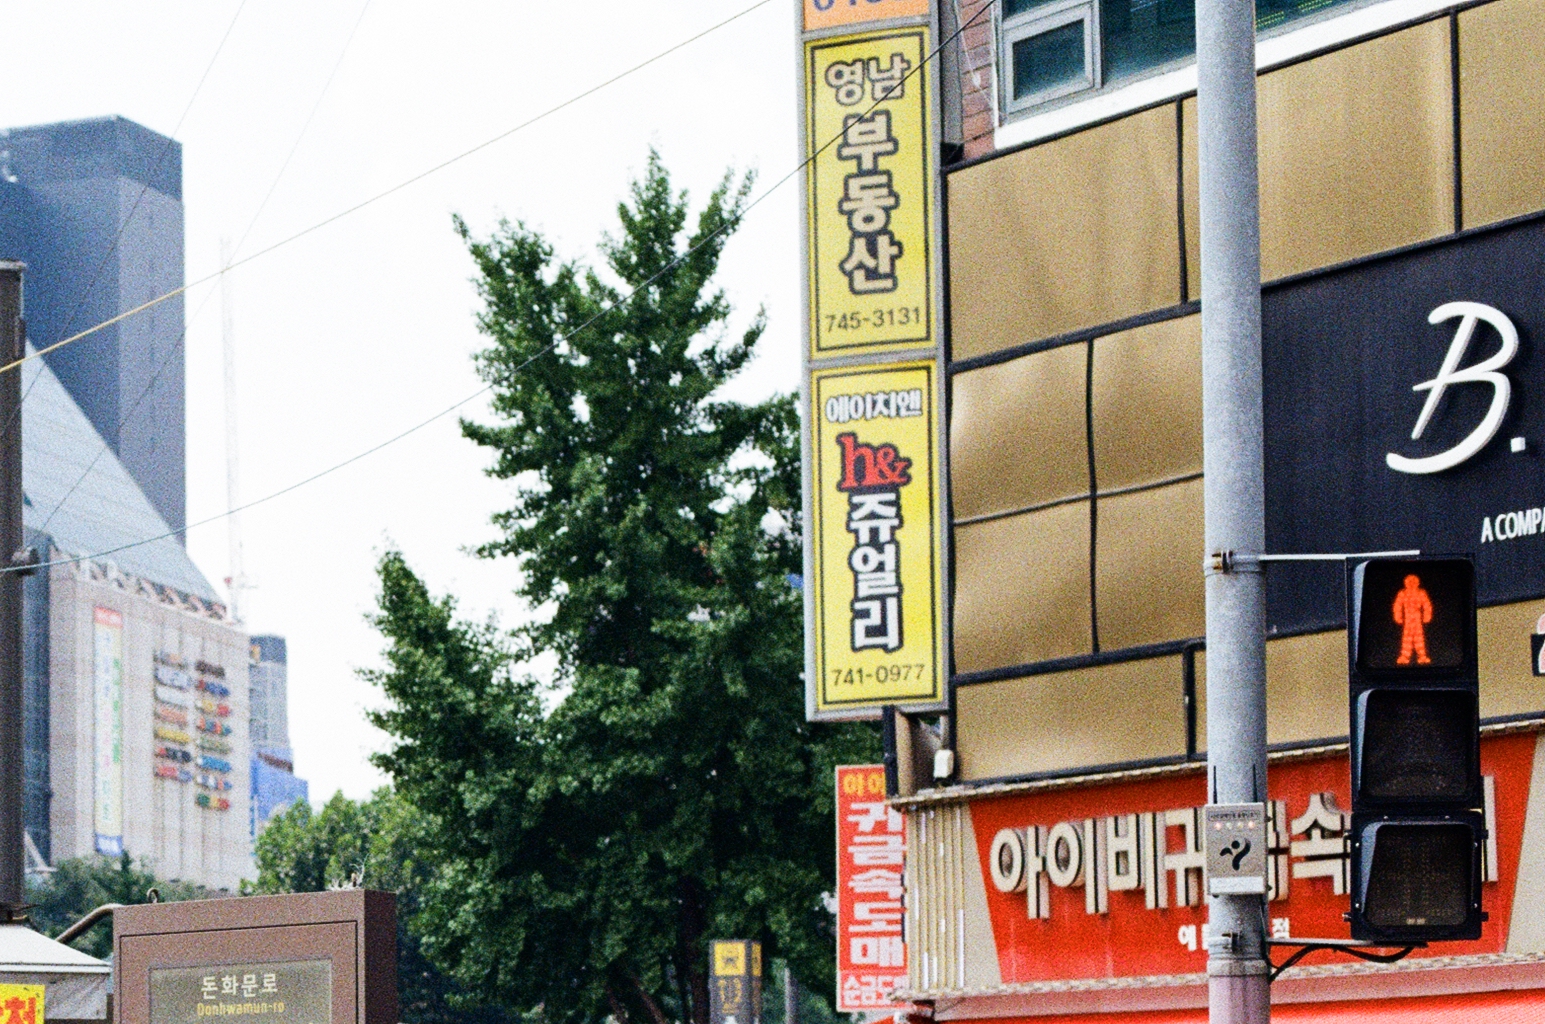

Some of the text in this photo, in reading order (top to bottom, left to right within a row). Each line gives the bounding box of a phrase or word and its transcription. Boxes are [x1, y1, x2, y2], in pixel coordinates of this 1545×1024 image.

[825, 52, 912, 106] 영남
[837, 110, 905, 296] 부동산
[825, 305, 922, 334] 745-3131
[824, 387, 923, 425] 에이치앤
[1481, 517, 1493, 543] A
[847, 490, 905, 654] 쥬얼리
[831, 663, 926, 687] 741-0977
[843, 773, 886, 796] 아이
[847, 802, 906, 968] 귀금속도매
[201, 973, 279, 1000] 돈화문로
[197, 1001, 285, 1017] Donhwamun-ro
